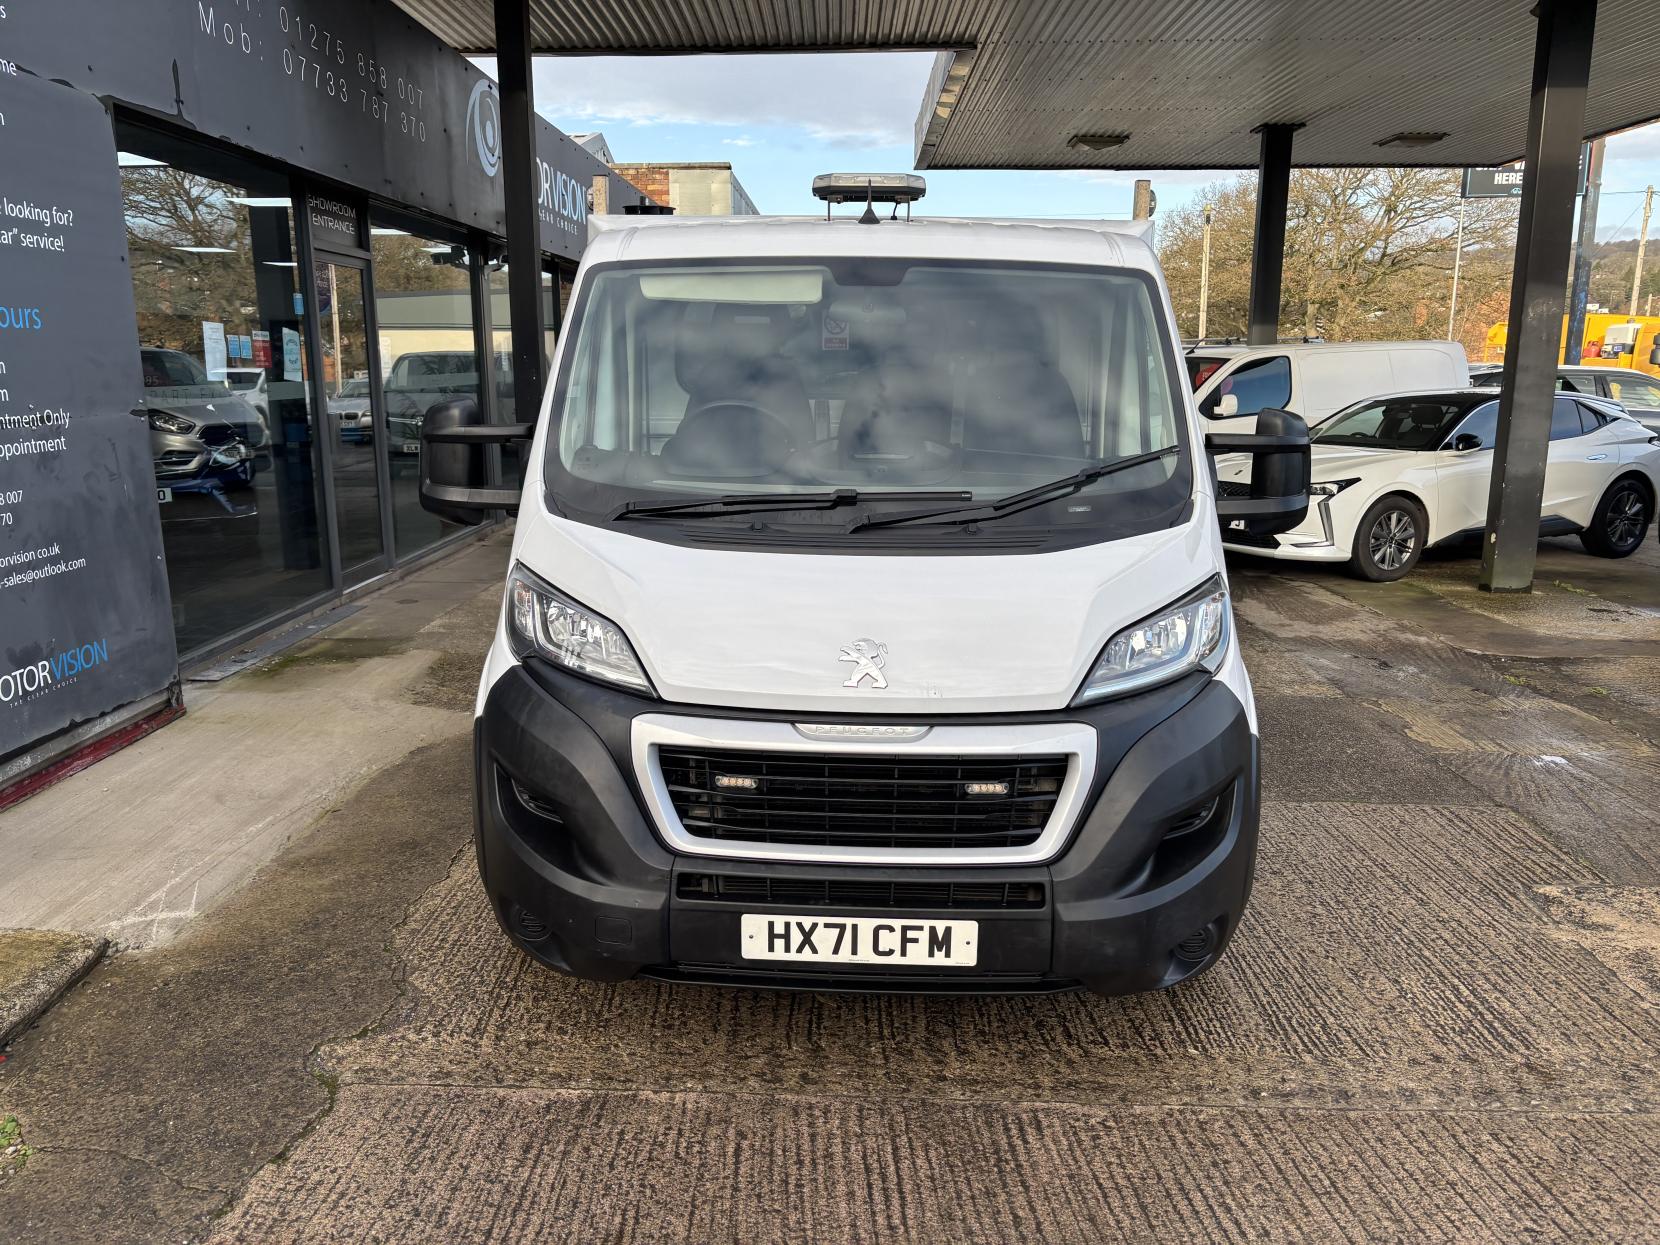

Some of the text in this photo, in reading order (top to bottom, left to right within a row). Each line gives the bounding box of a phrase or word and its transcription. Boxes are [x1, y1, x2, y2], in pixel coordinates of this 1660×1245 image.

[279, 6, 345, 64] 01275
[357, 52, 387, 89] 858
[397, 77, 423, 111] 007
[283, 48, 348, 102] 07733
[360, 89, 389, 123] 787
[400, 111, 426, 142] 370
[1493, 172, 1524, 185] HERE
[3, 197, 51, 227] looking
[52, 206, 73, 226] for?
[307, 194, 357, 219] SHOWROOM
[312, 213, 356, 235] ENTRANCE
[20, 232, 65, 252] service!
[43, 408, 70, 429] Only
[6, 490, 23, 504] 007
[0, 558, 87, 590] -sales@outlook.com
[767, 920, 953, 959] HX71 CFM
